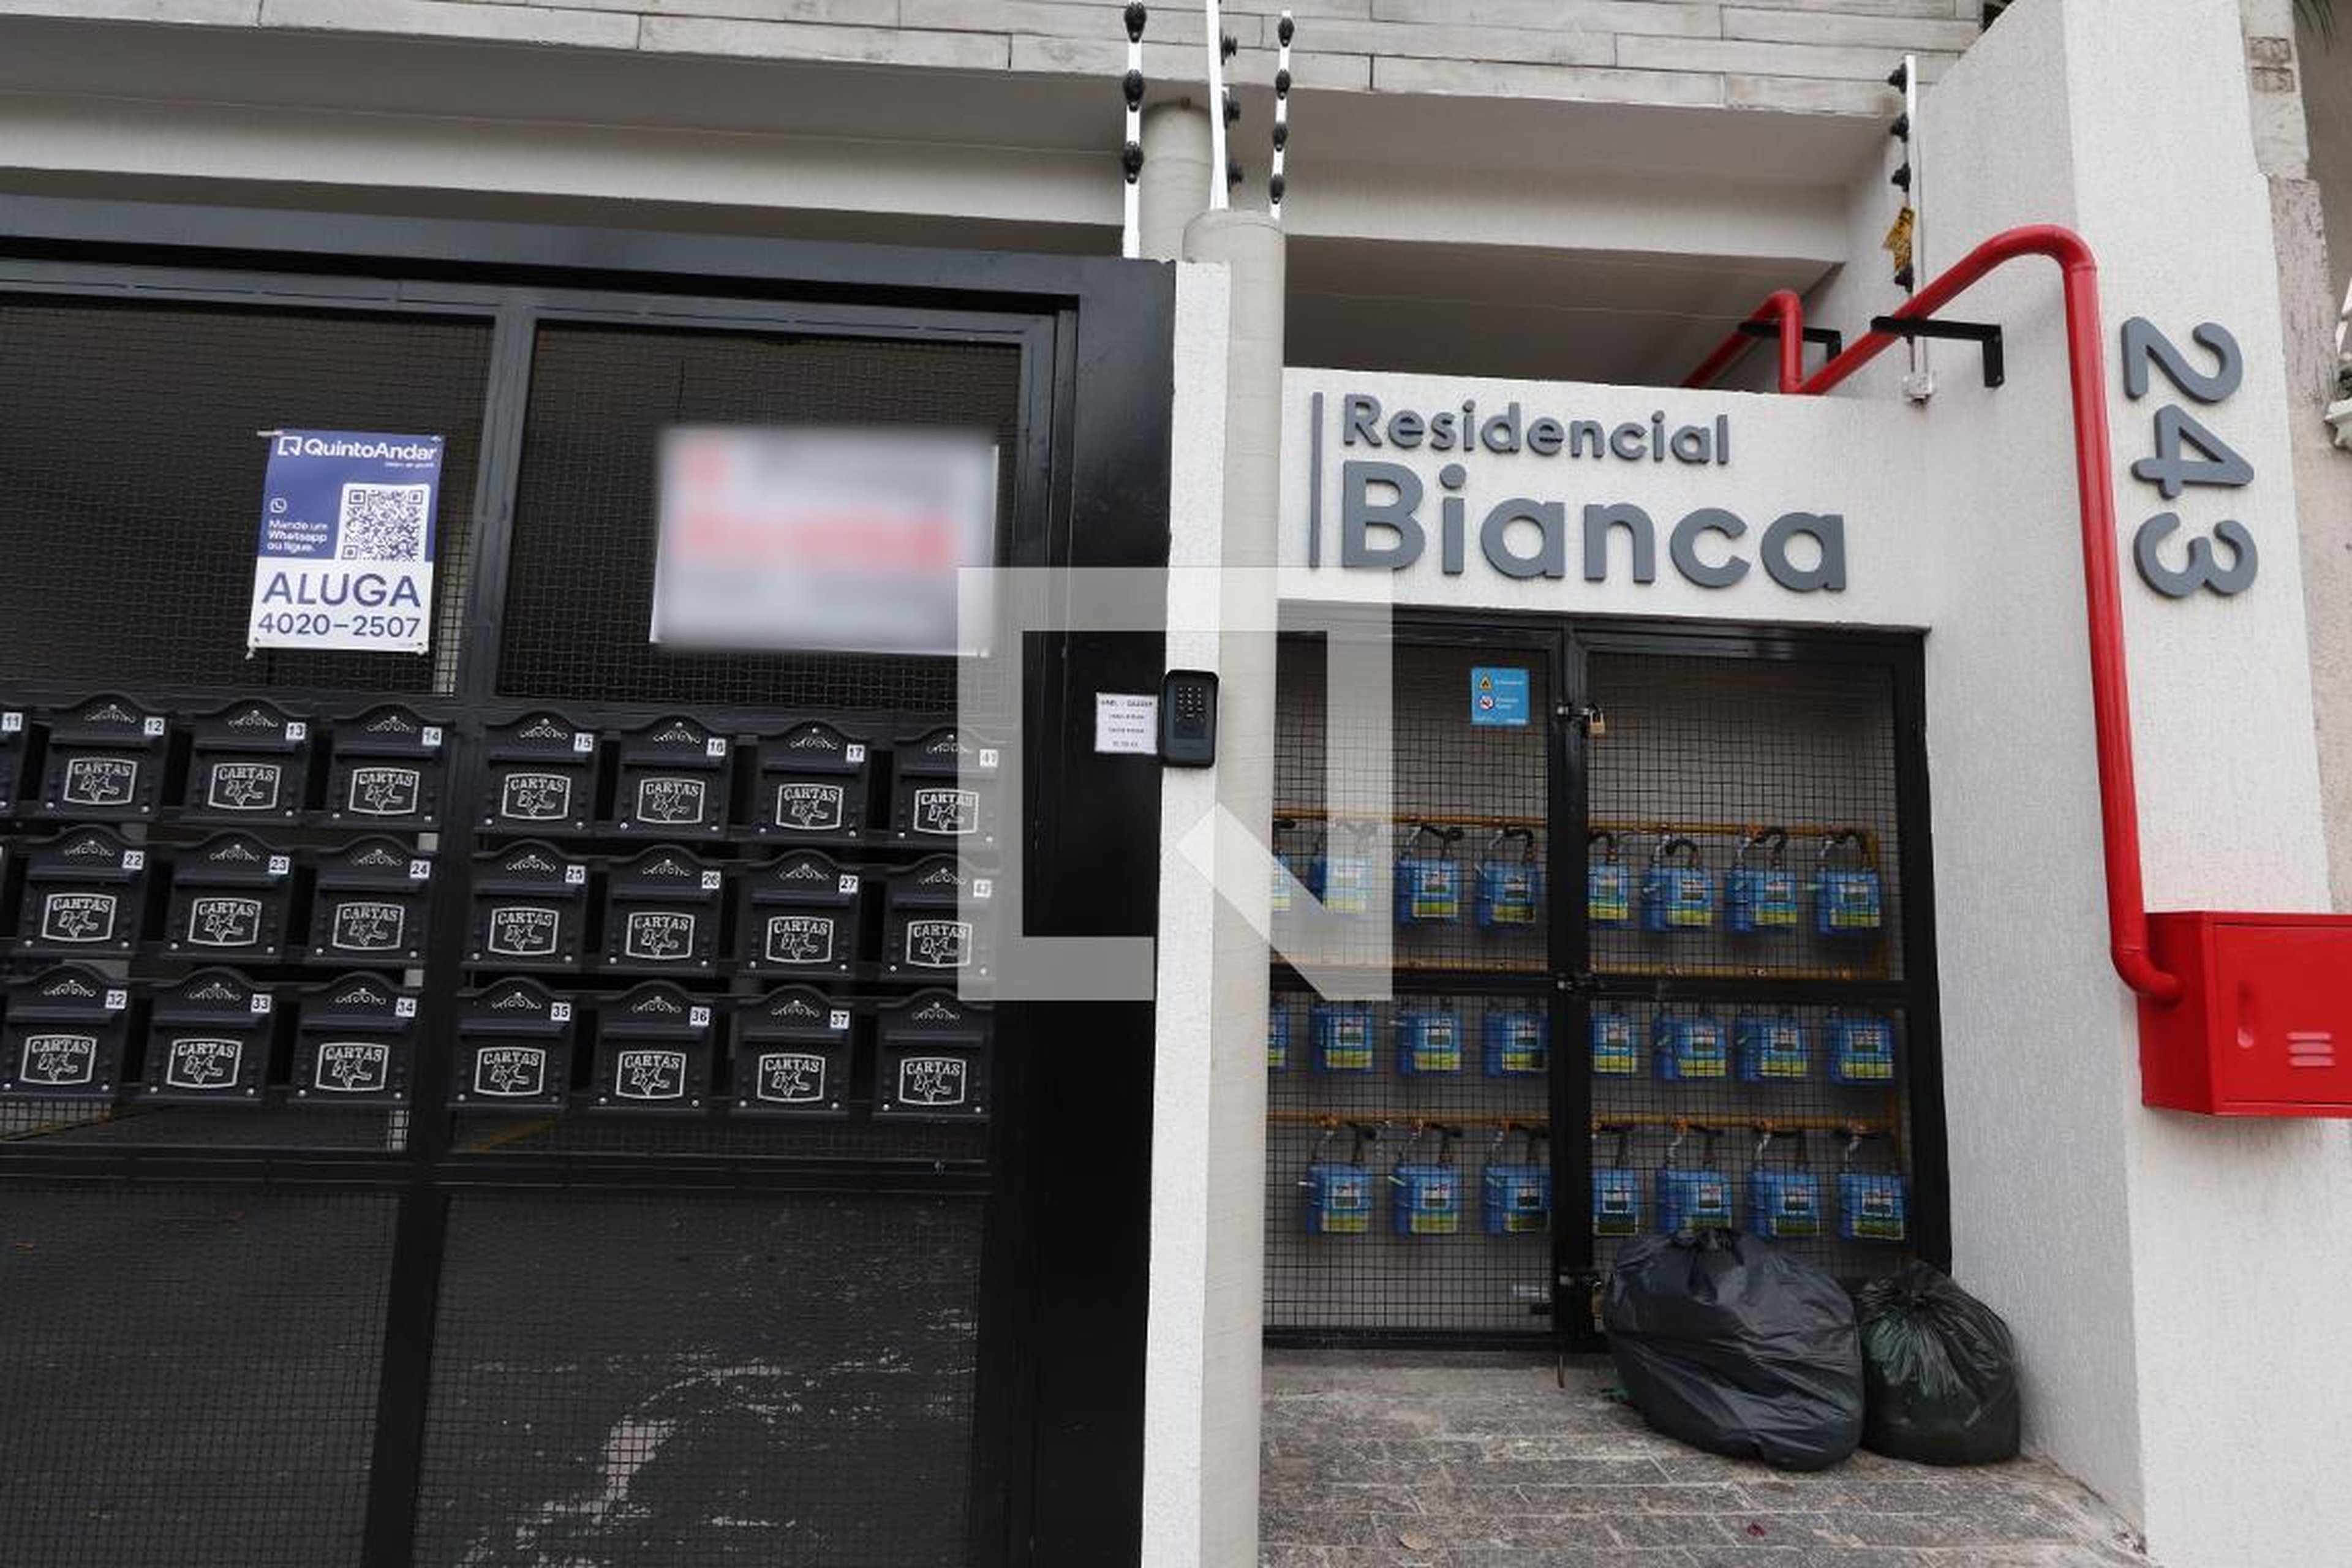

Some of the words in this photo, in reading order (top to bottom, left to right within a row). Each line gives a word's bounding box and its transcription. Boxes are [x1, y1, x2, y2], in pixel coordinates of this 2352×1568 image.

[306, 438, 437, 460] QuintoAndar
[1343, 393, 1729, 466] Residencial
[2121, 316, 2258, 597] 243
[1341, 460, 1846, 592] Bianca
[262, 571, 421, 608] ALUGA
[258, 614, 421, 638] 4020-2507
